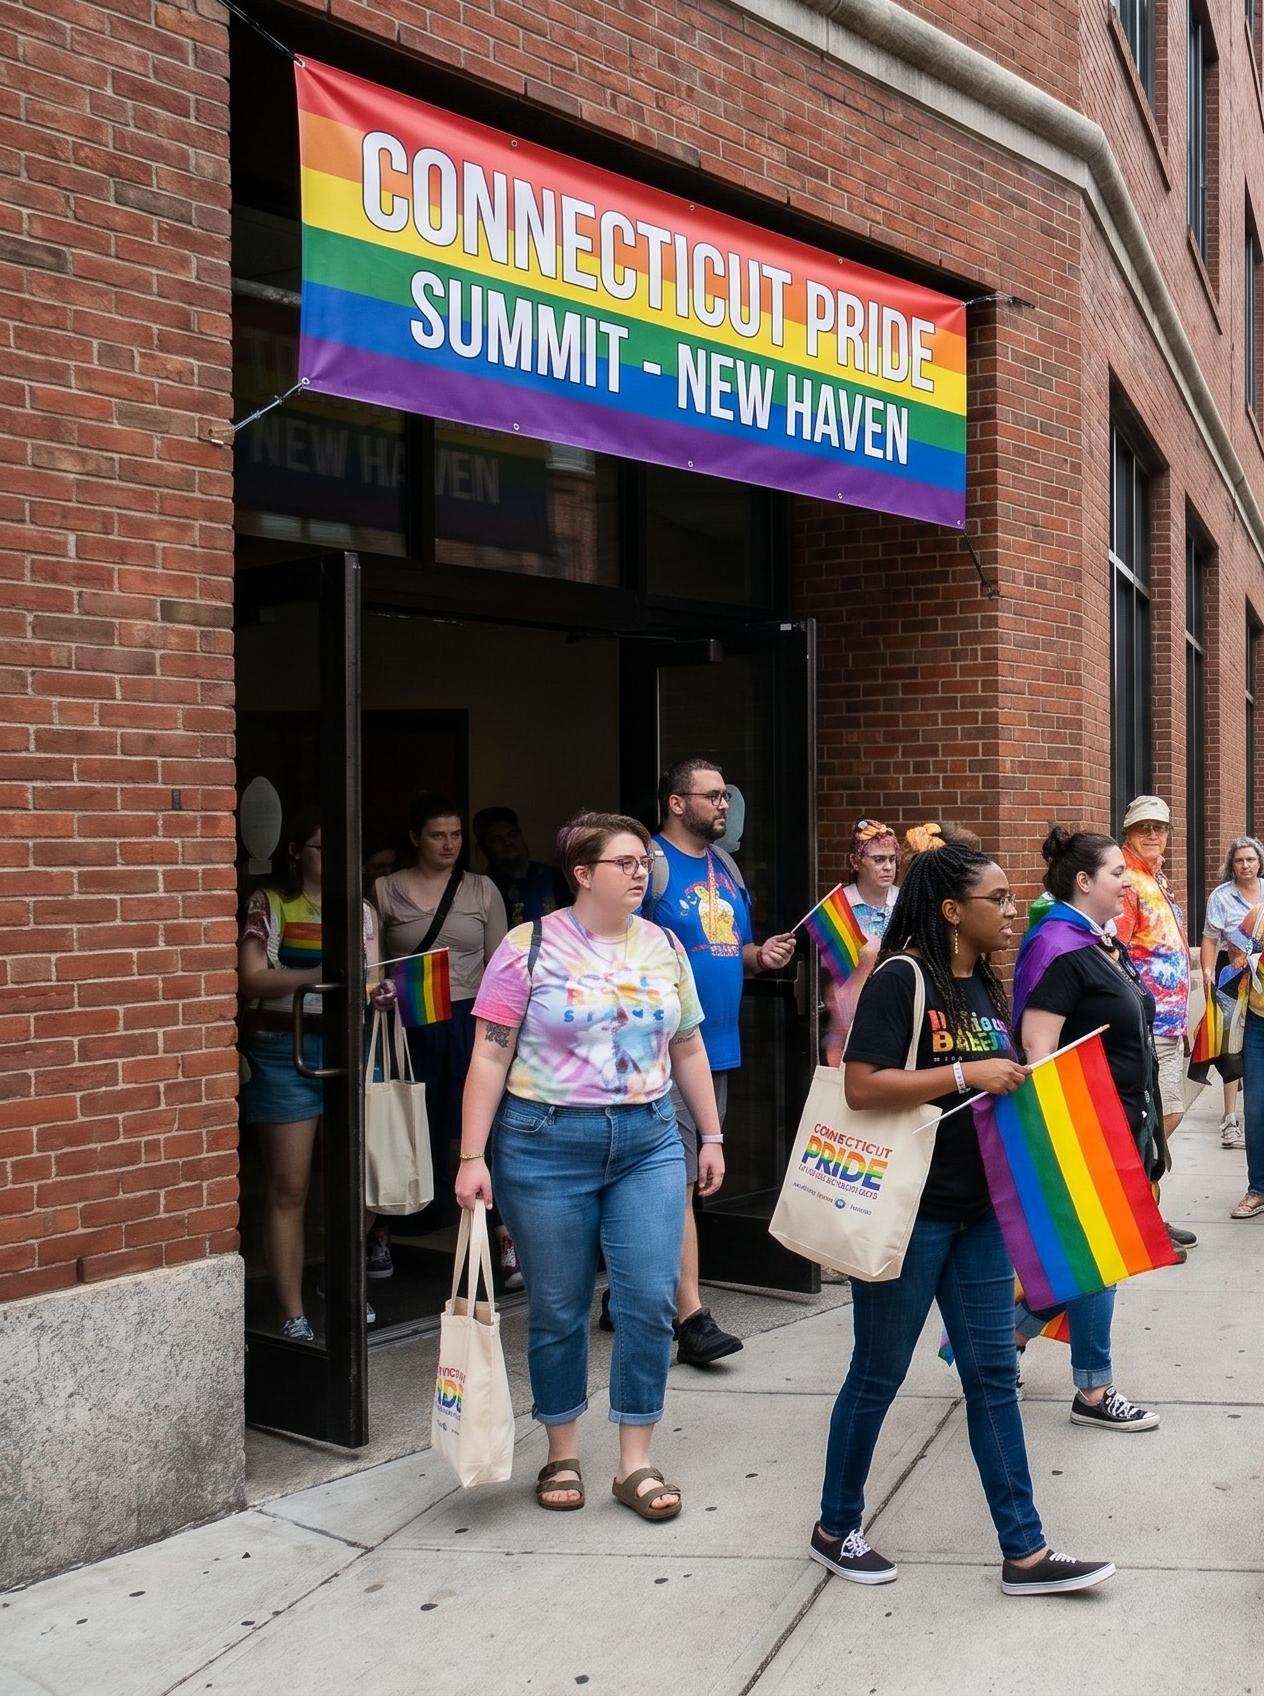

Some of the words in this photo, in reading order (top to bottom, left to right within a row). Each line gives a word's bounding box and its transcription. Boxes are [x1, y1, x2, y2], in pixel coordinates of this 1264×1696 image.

[362, 132, 792, 347] CONNECTICUT
[807, 284, 935, 393] PRIDE
[410, 270, 628, 393] SUMMIT
[677, 344, 774, 430] NEW
[786, 379, 909, 466] HAVEN
[801, 1135, 888, 1191] PRIDE
